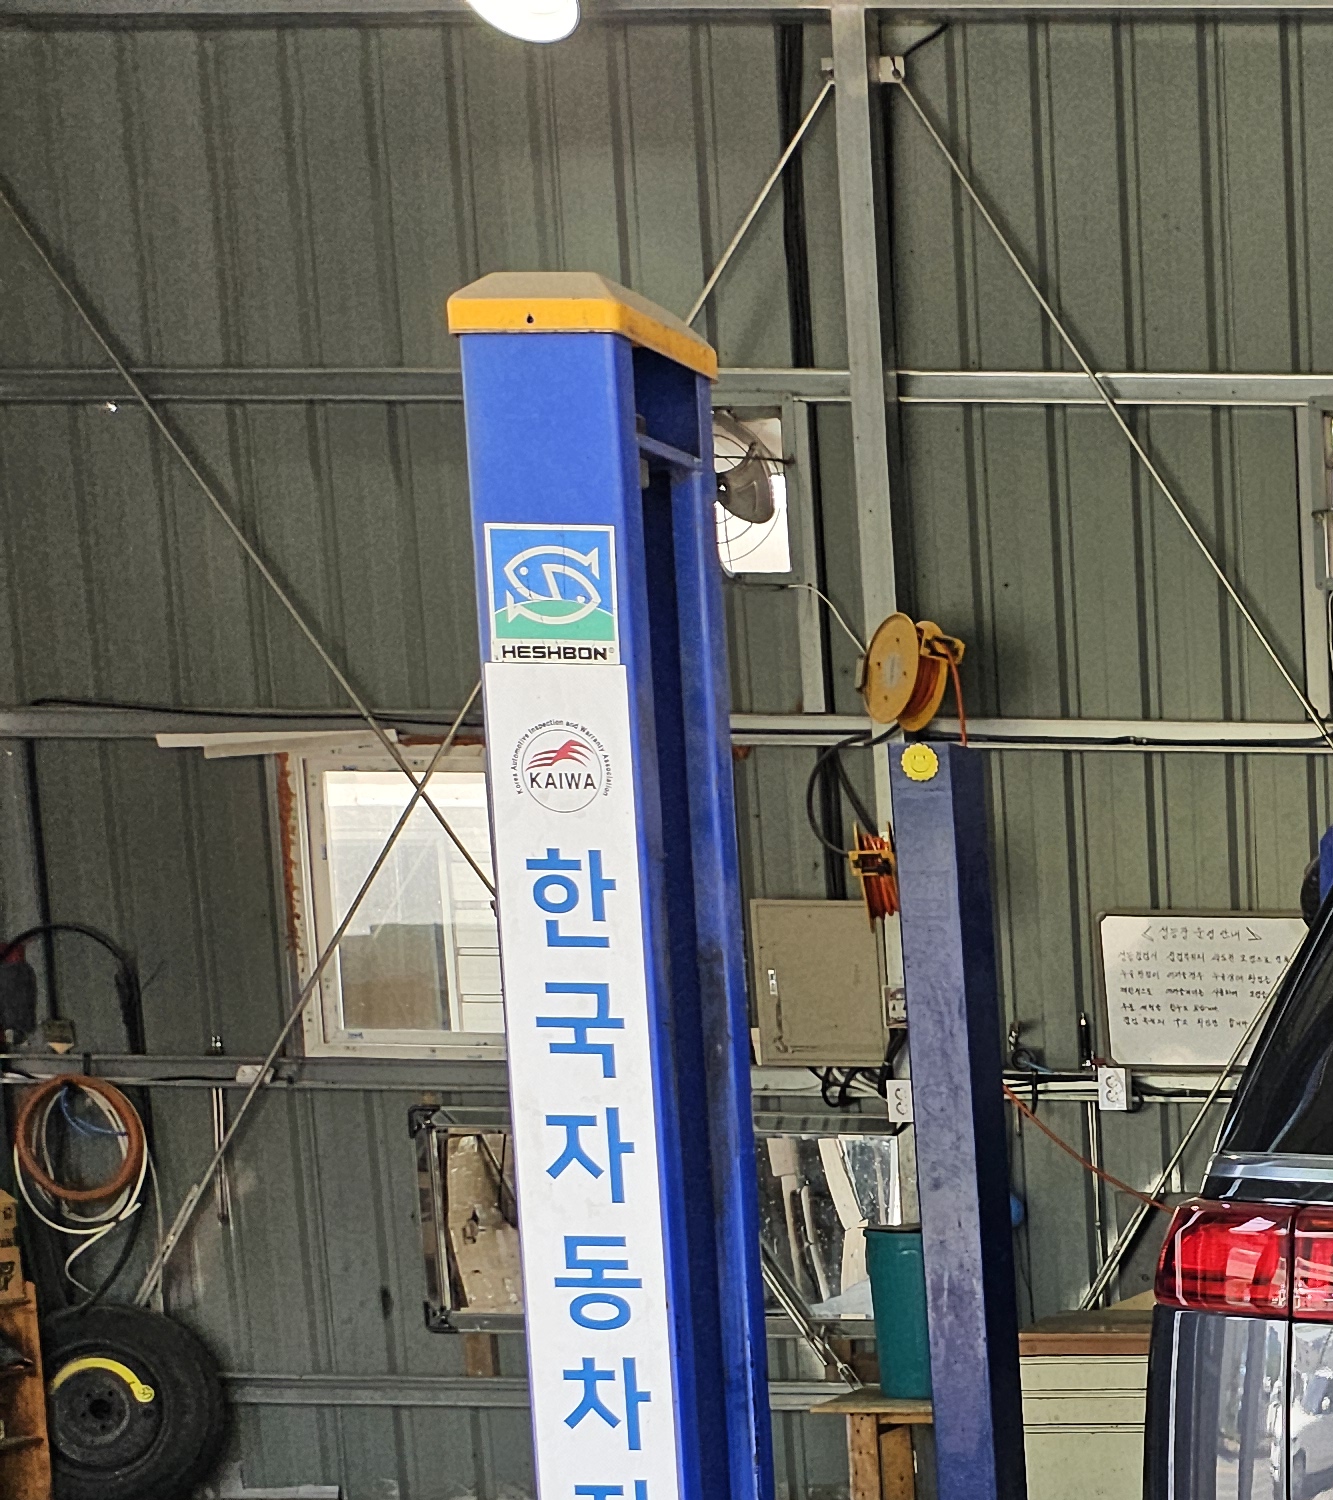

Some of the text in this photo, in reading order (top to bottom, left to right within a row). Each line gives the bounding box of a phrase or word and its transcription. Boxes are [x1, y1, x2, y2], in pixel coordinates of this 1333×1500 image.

[502, 645, 608, 661] HESHBON
[528, 719, 564, 735] Inspection
[529, 772, 597, 789] KAIWA
